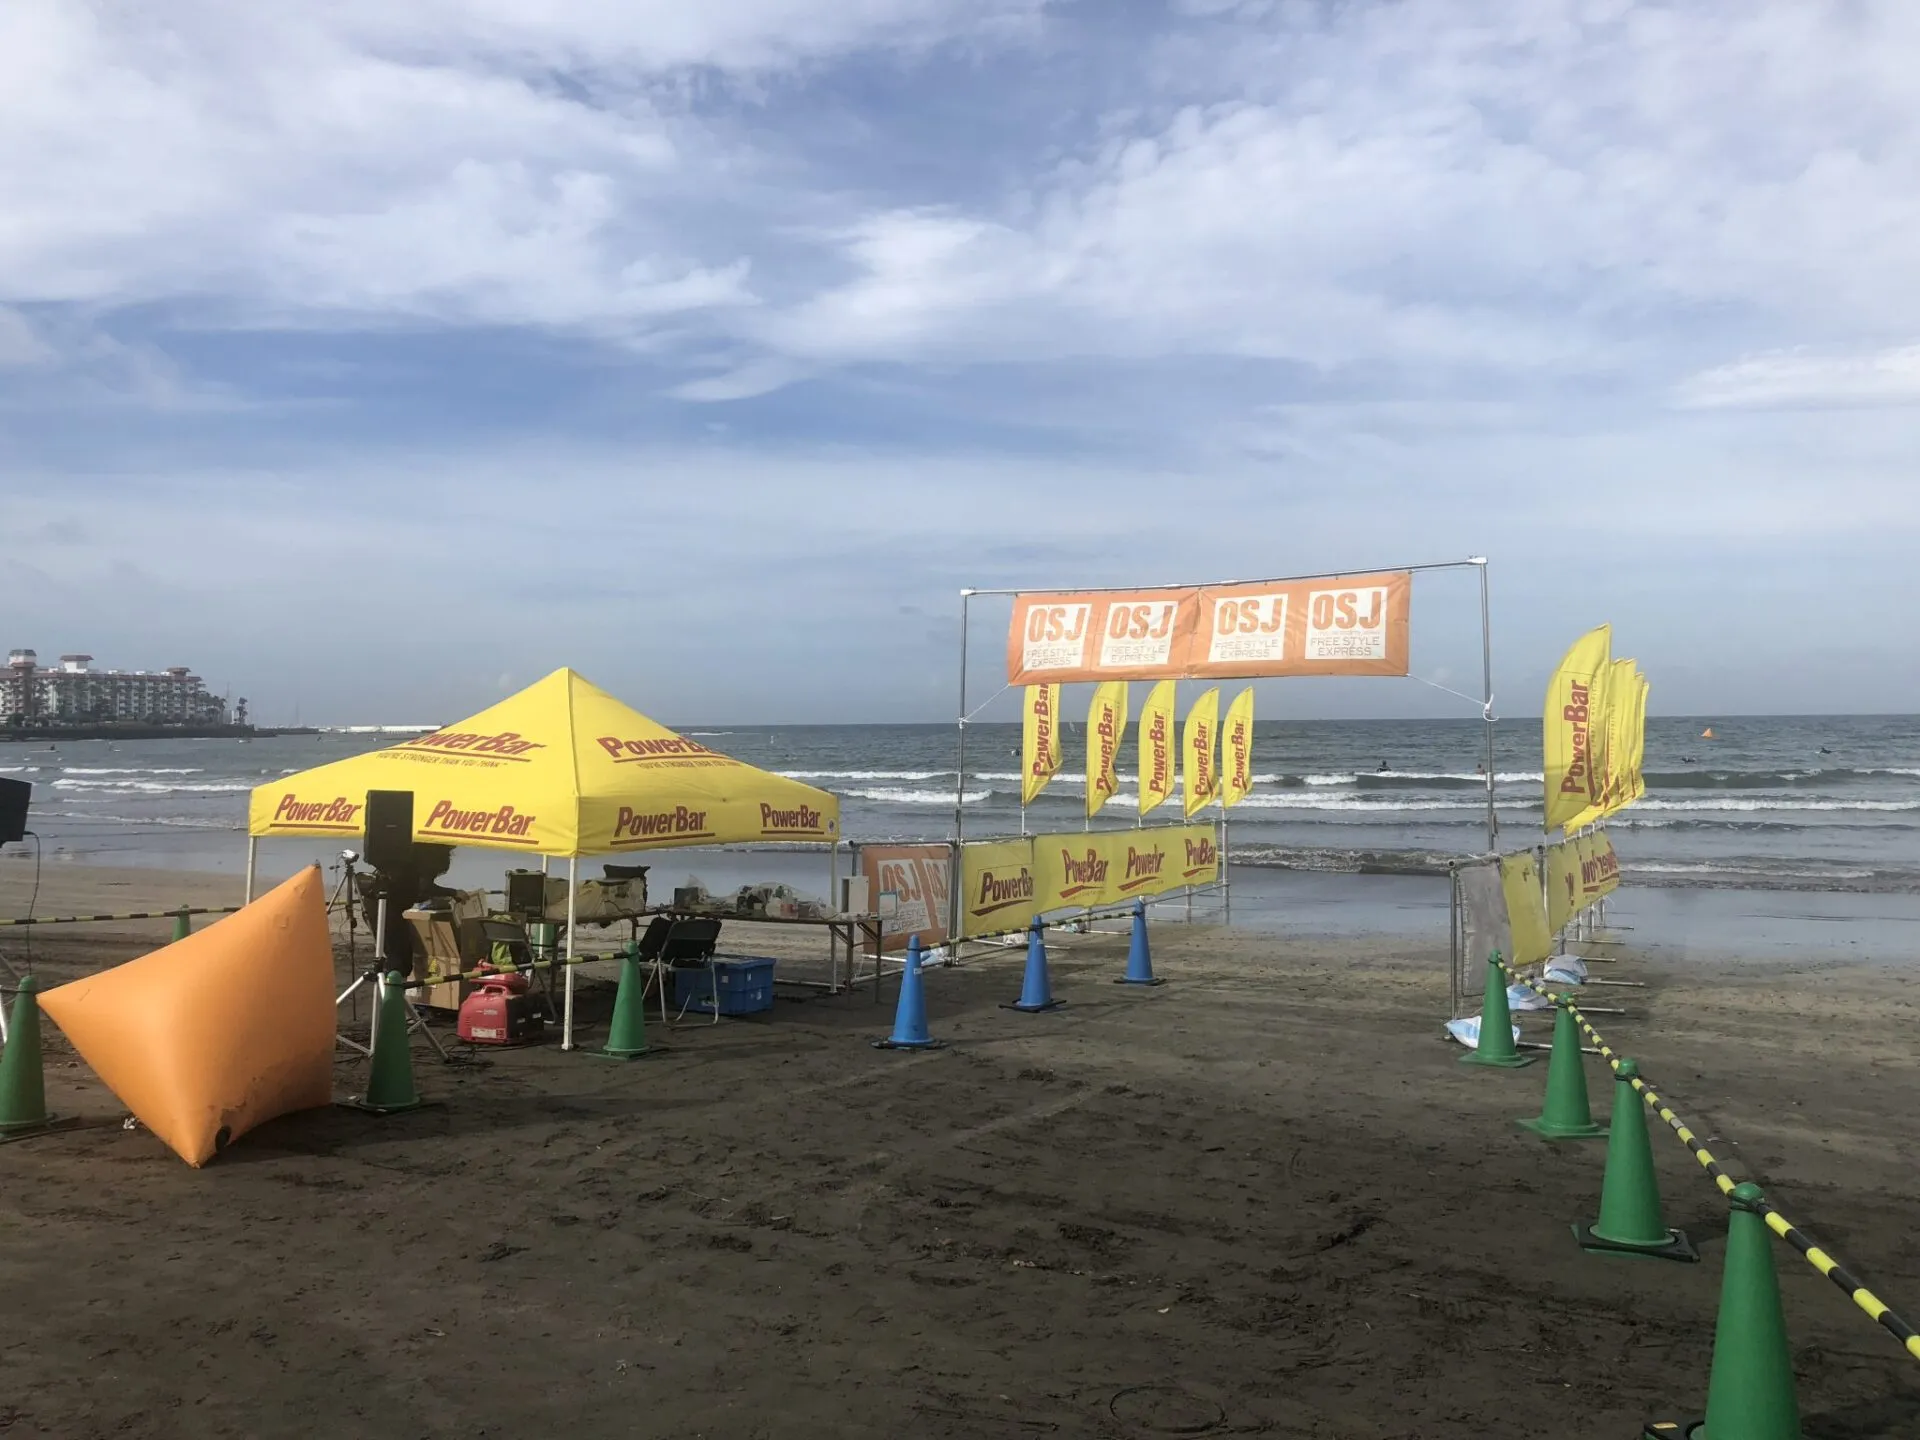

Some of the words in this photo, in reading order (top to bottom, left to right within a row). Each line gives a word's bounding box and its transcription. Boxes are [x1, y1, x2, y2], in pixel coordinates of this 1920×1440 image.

[1028, 607, 1087, 642] OSJ
[1109, 605, 1174, 639] OSJ
[1217, 598, 1283, 635] OSJ
[1312, 591, 1382, 630] OSJ
[1031, 658, 1072, 668] EXPRESS
[1111, 654, 1156, 663] EXPRESS
[1220, 649, 1270, 659] EXPRESS
[1317, 647, 1372, 657] EXPRESS
[407, 732, 547, 755] owerBar
[1149, 711, 1165, 793] PowerBar
[1561, 680, 1589, 793] PowerBar
[1194, 722, 1208, 796] PowerBar
[1232, 720, 1244, 789] PowerBar
[274, 794, 362, 823] PowerBar
[425, 800, 536, 836] PowerBar
[614, 806, 706, 837] PowerBar
[760, 802, 821, 828] PowerBar
[882, 864, 922, 902] OSJ
